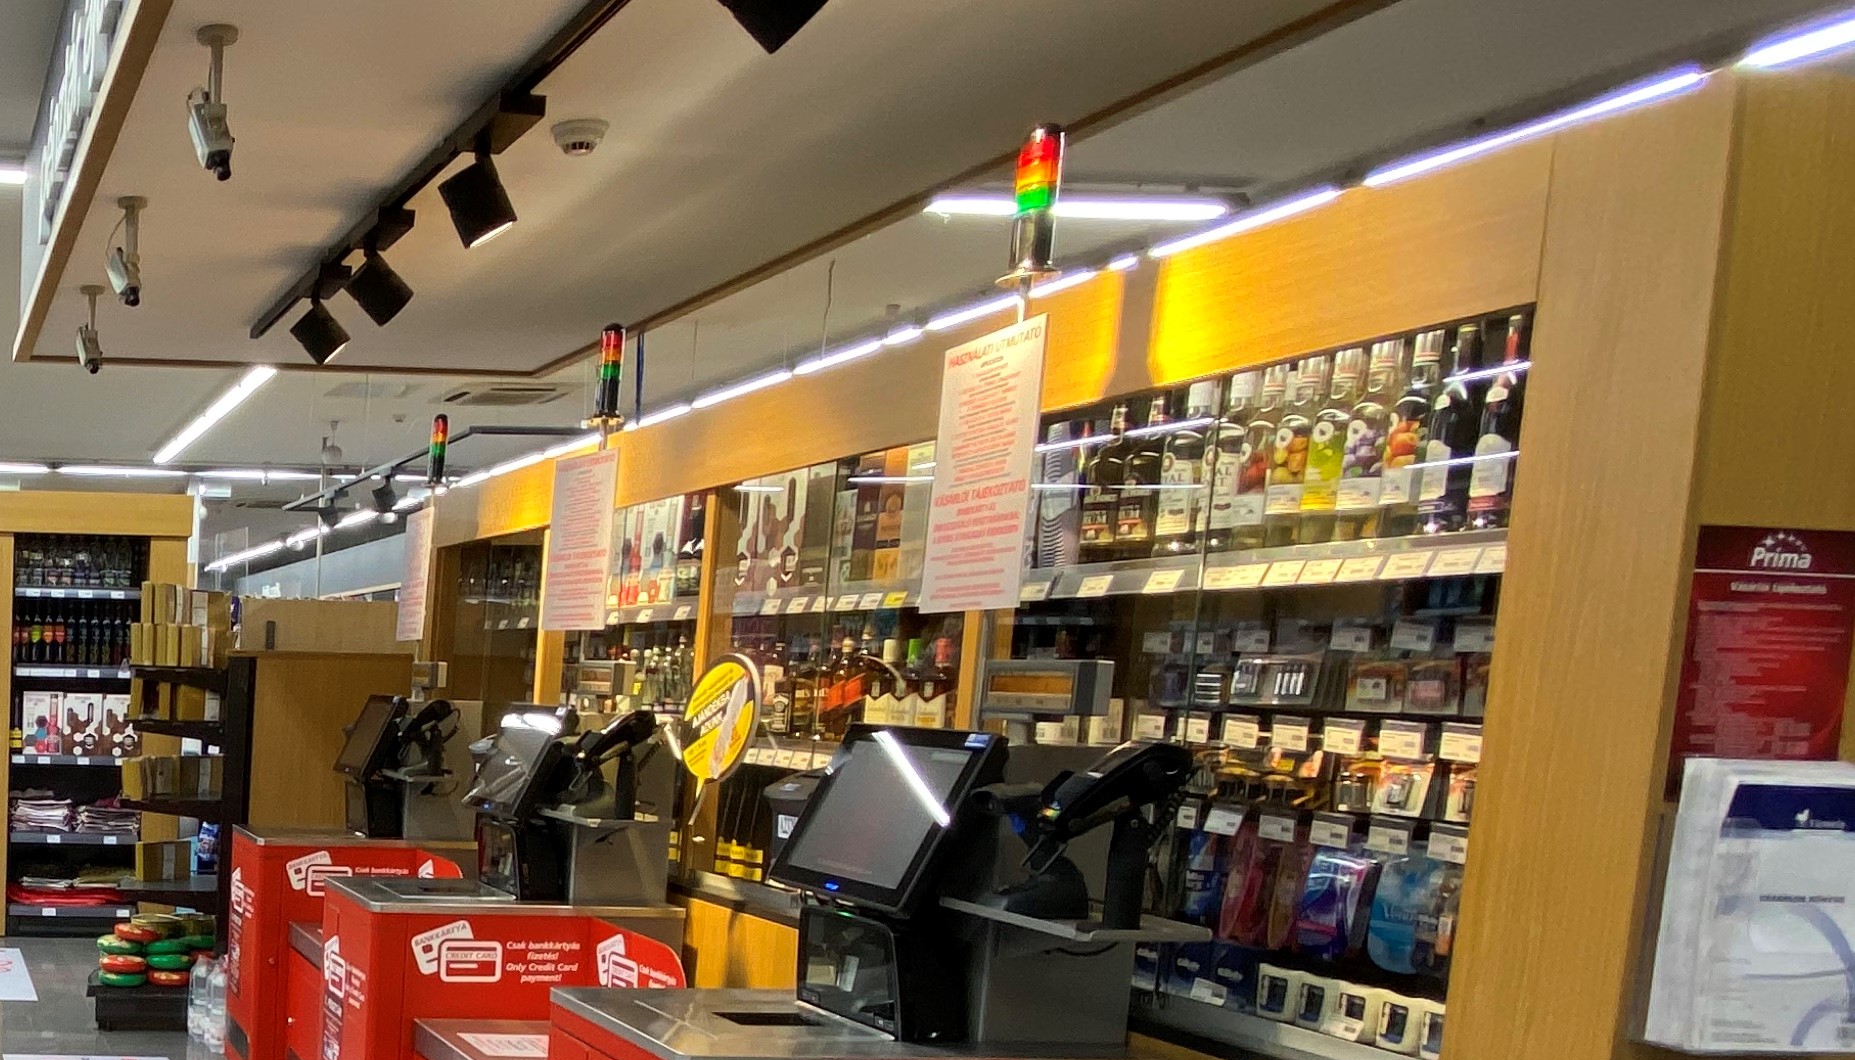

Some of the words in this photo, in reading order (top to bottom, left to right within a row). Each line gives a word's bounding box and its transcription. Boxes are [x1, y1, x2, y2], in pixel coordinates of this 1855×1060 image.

[1750, 546, 1812, 570] Prima
[506, 941, 526, 950] Csak
[445, 951, 474, 960] CREDIT
[475, 951, 498, 960] CARD
[506, 962, 526, 973] Only
[528, 962, 555, 972] Credit
[557, 962, 578, 972] Card
